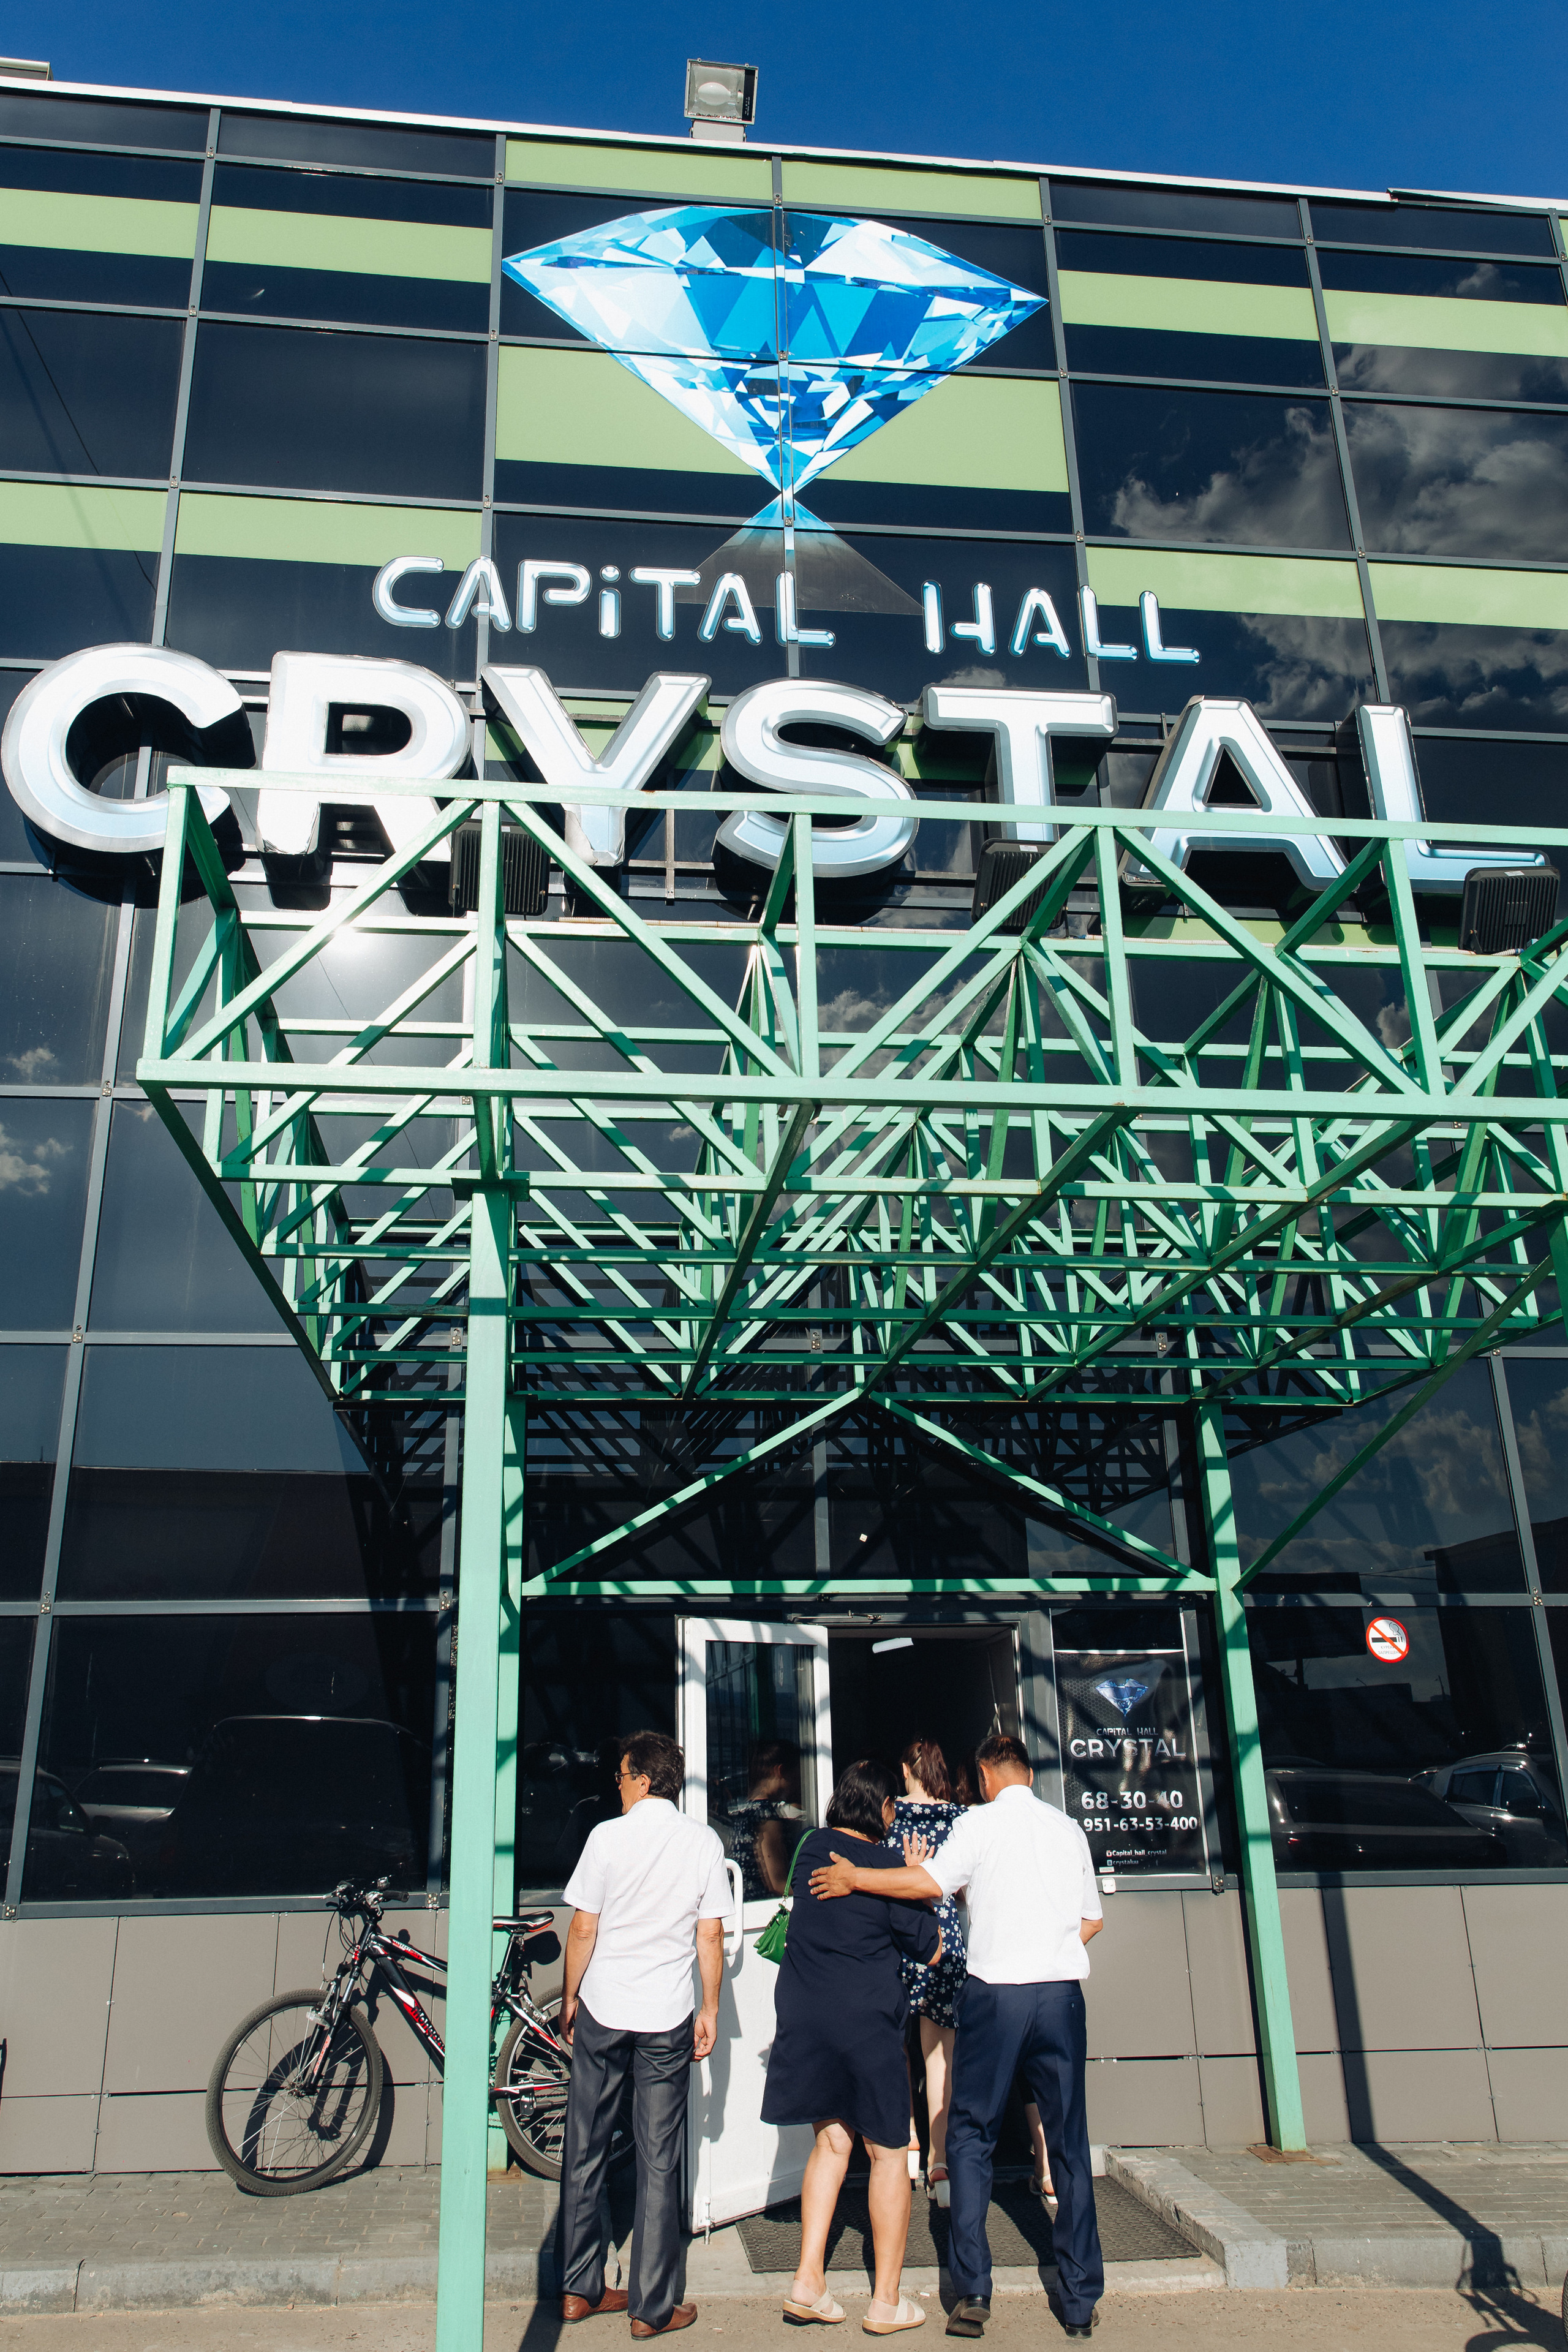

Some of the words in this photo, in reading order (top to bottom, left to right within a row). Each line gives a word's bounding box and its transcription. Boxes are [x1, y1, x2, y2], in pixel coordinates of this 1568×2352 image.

[923, 579, 1202, 665] HALL
[1, 641, 1550, 895] CRYSTAL
[1070, 1738, 1186, 1758] CRYSTAL
[1081, 1790, 1183, 1809] 68-30-40
[1084, 1816, 1197, 1831] 951-63-53-400
